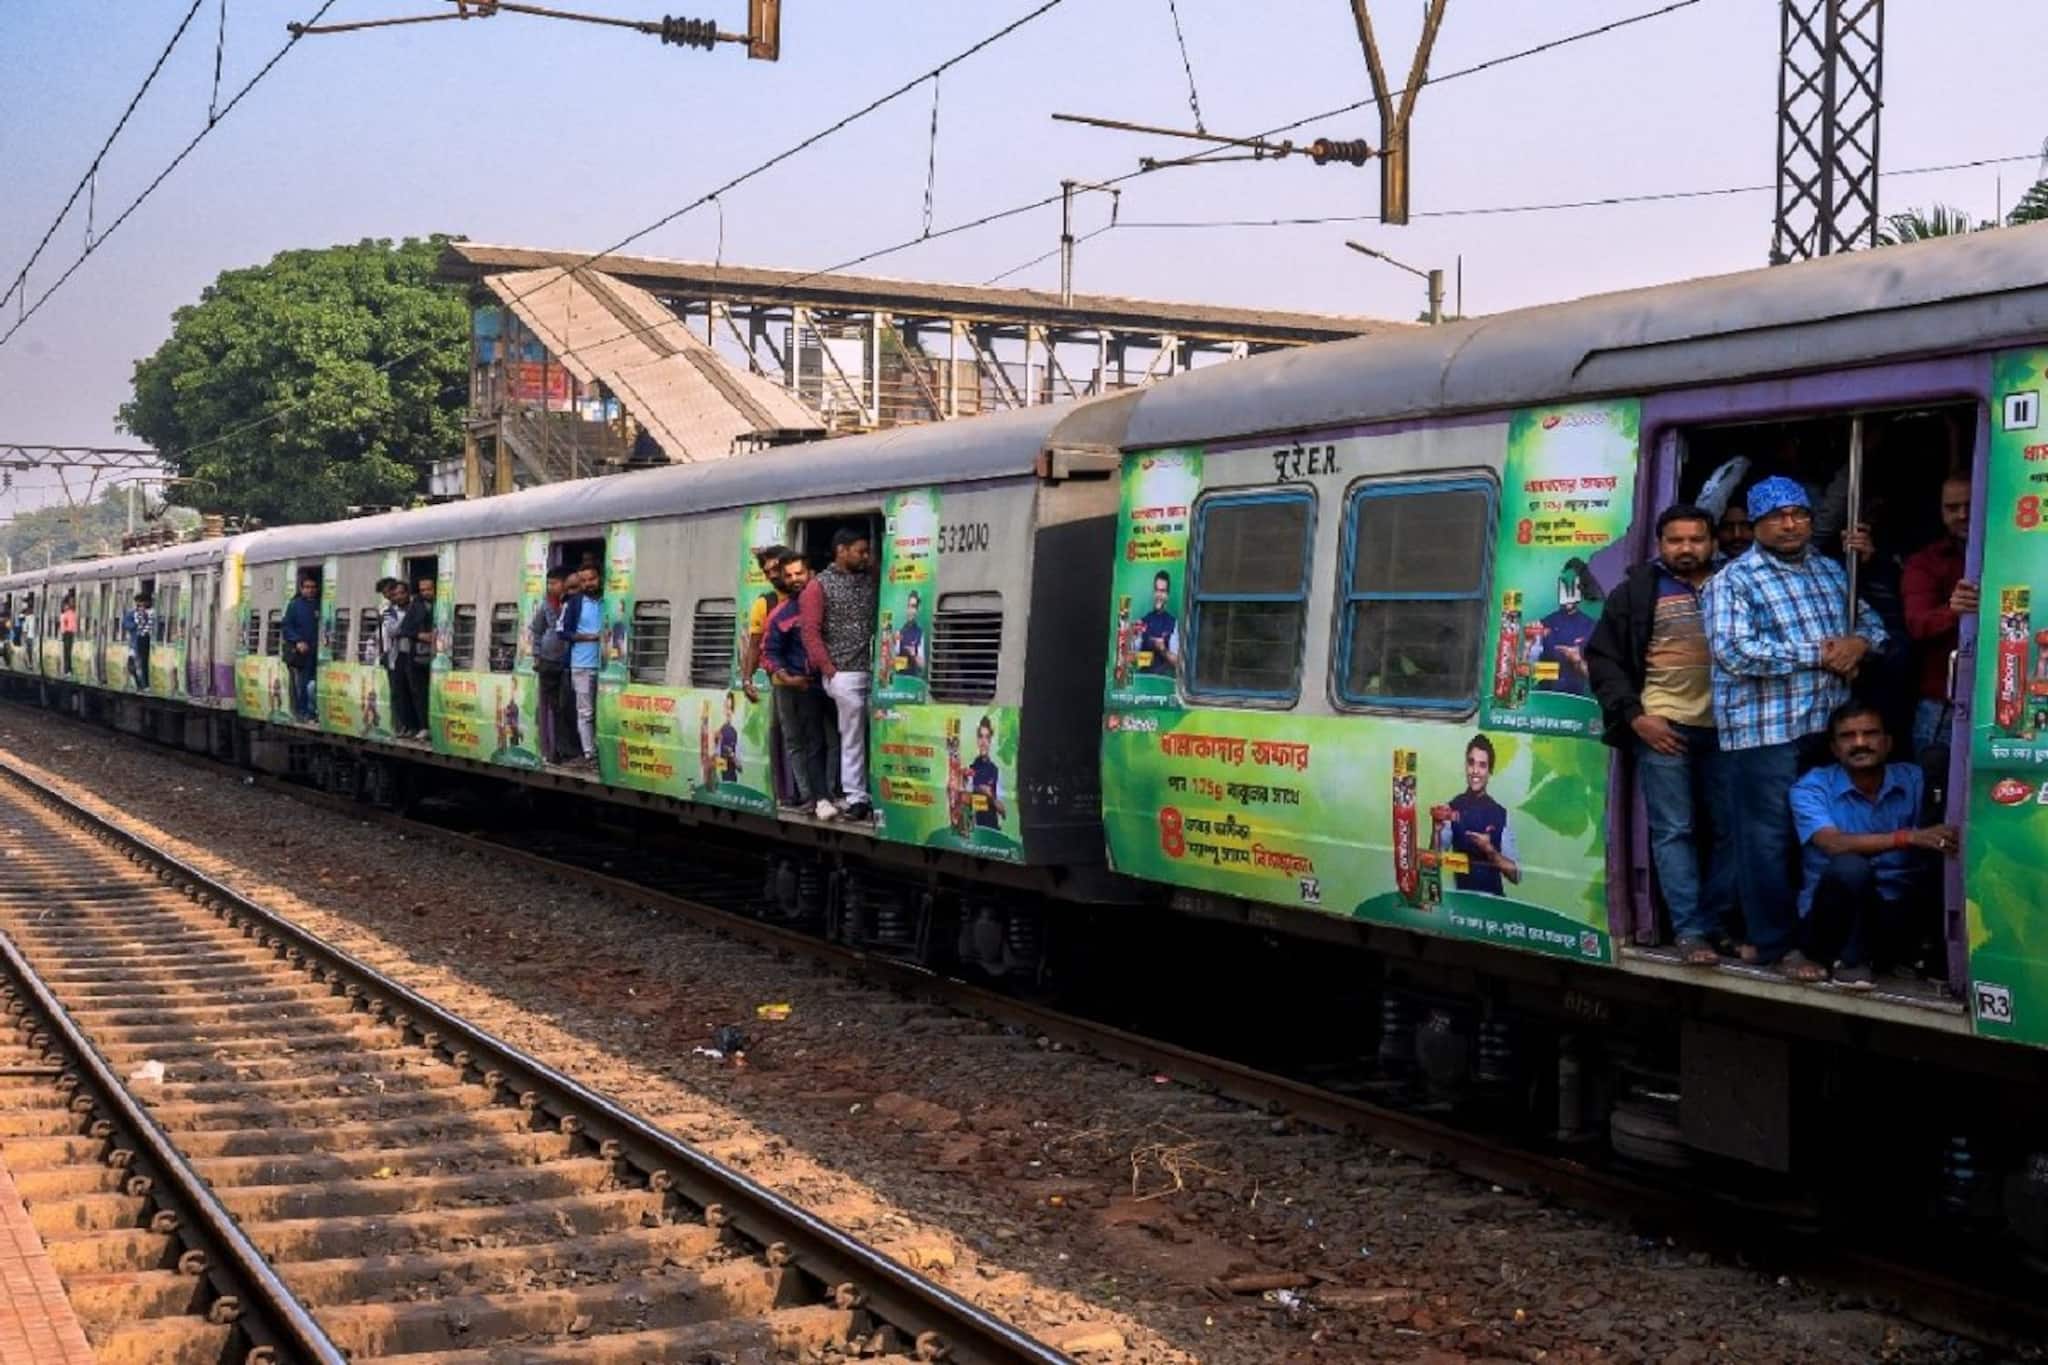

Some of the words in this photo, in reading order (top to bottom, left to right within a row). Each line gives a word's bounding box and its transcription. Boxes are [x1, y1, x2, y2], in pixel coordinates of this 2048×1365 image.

[1251, 740, 1310, 772] অফার
[1192, 777, 1224, 801] 175g
[1978, 993, 2010, 1018] R3
